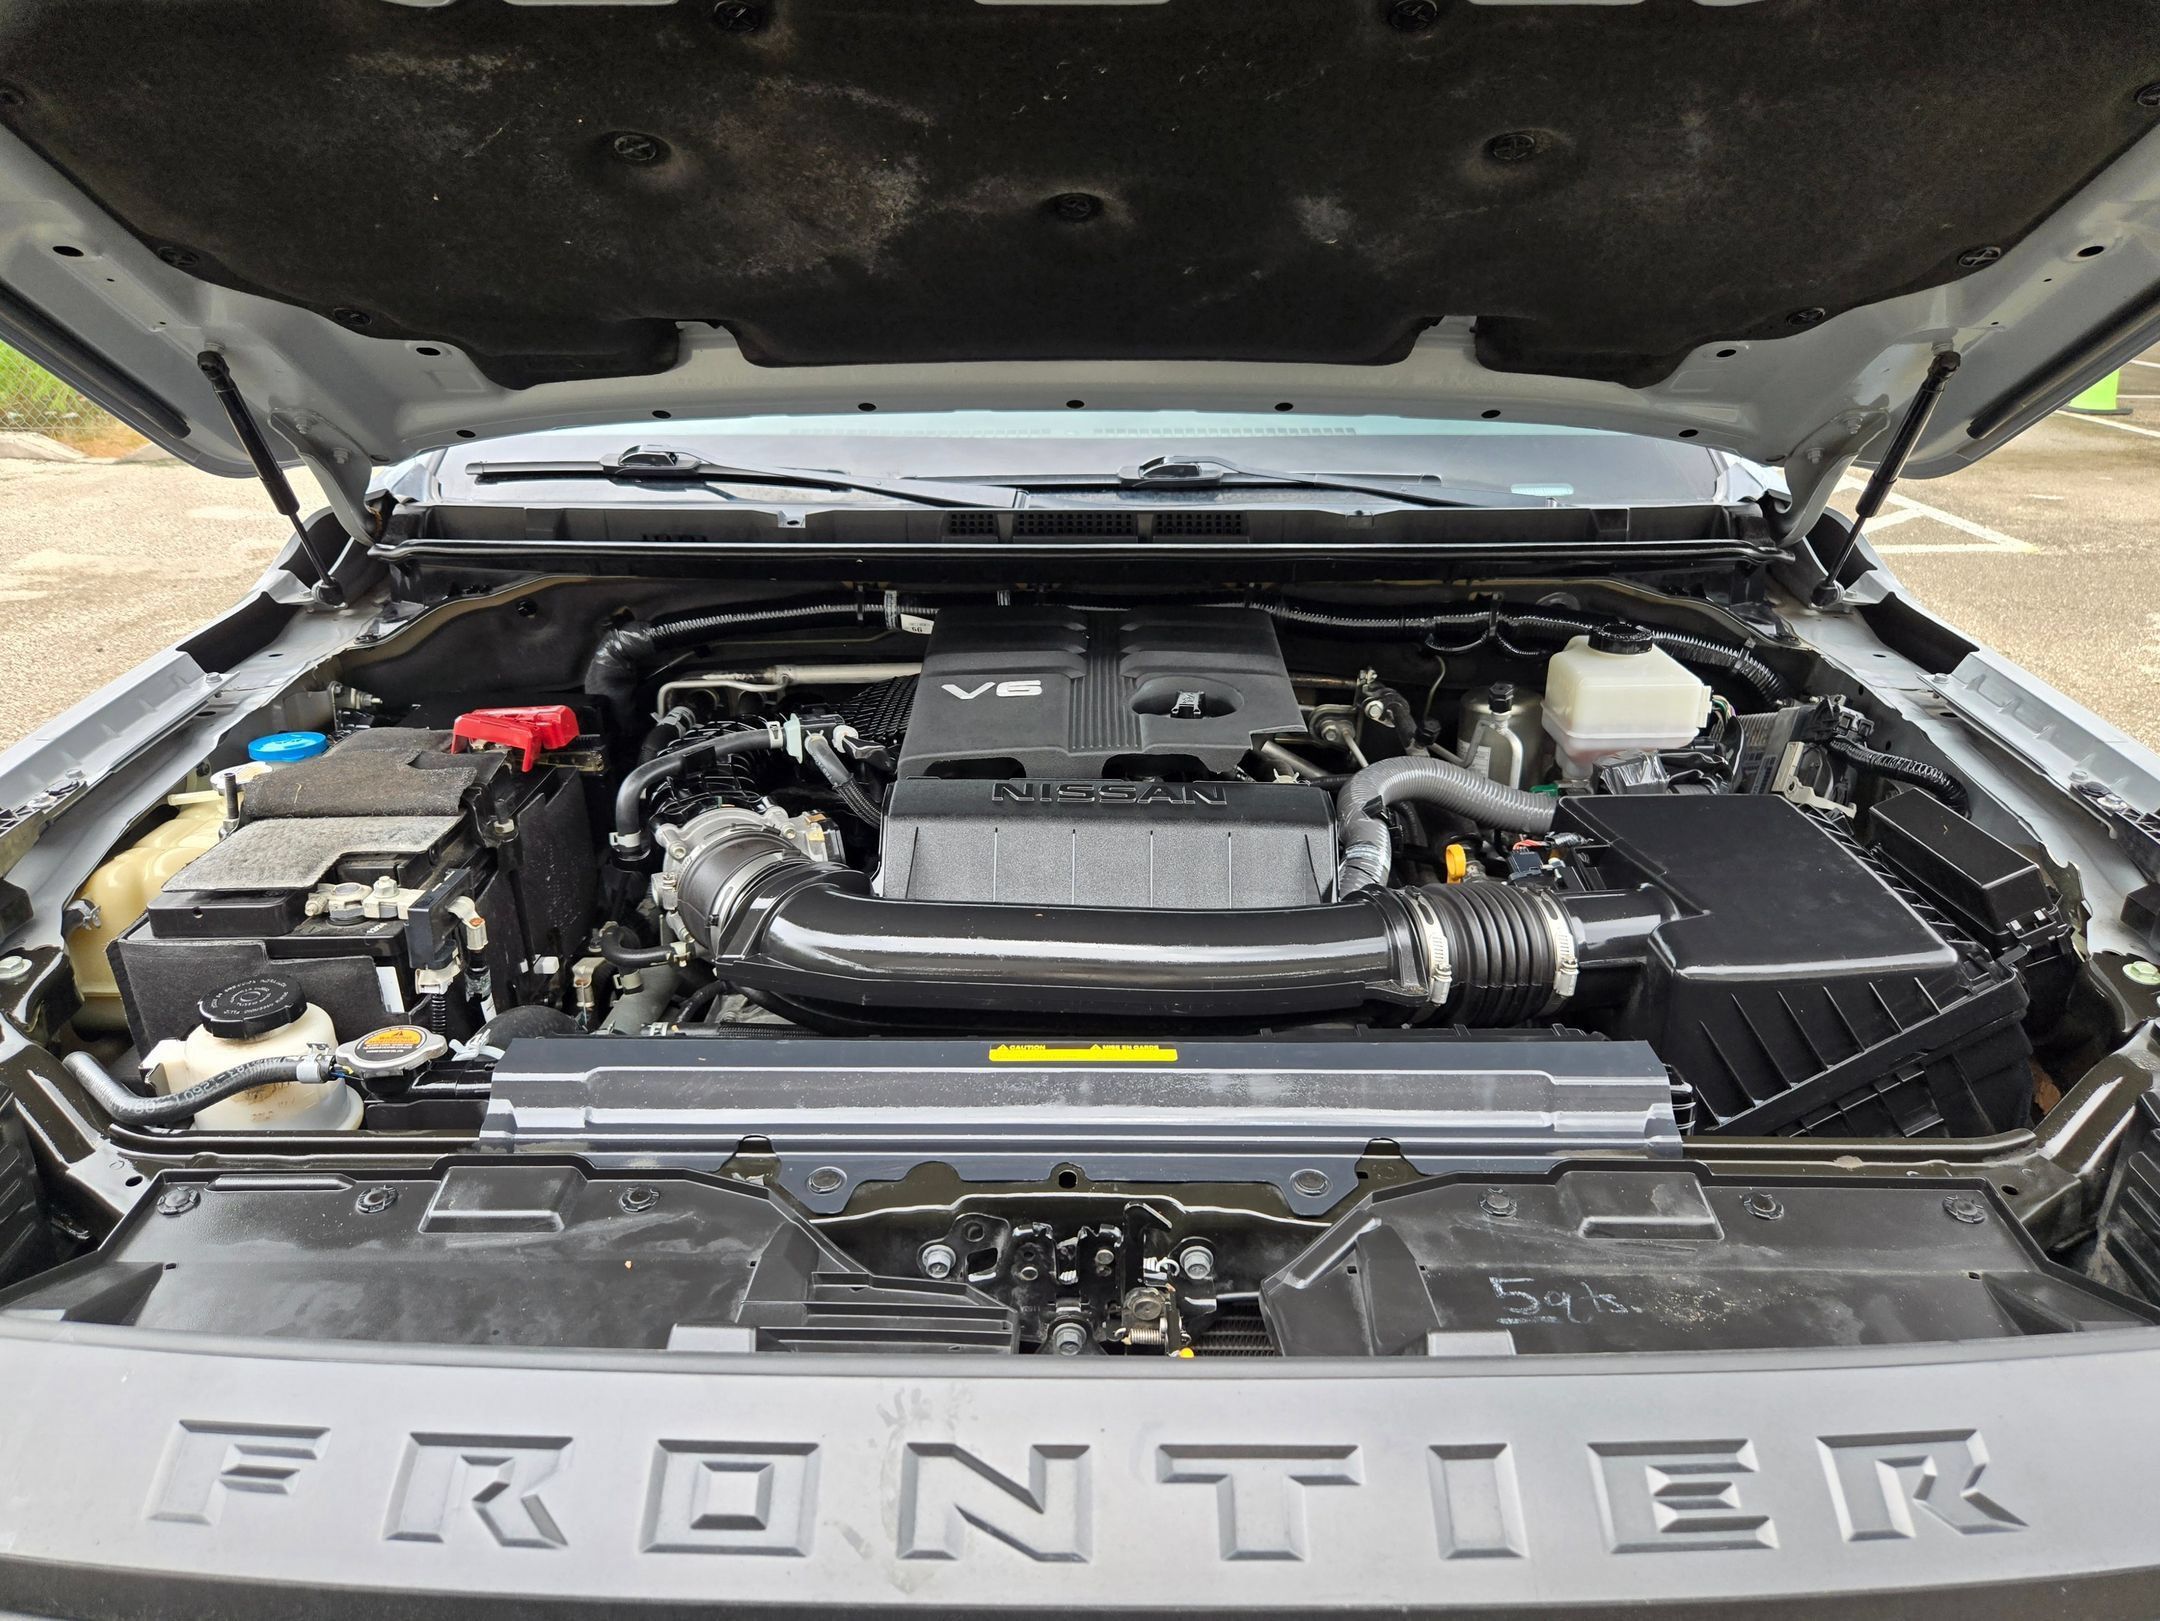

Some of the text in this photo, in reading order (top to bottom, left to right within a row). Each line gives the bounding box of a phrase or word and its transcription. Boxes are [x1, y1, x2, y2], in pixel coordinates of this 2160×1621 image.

[941, 679, 1043, 700] V6
[992, 782, 1227, 806] NISSAN
[146, 1418, 2030, 1562] FRONTIER
